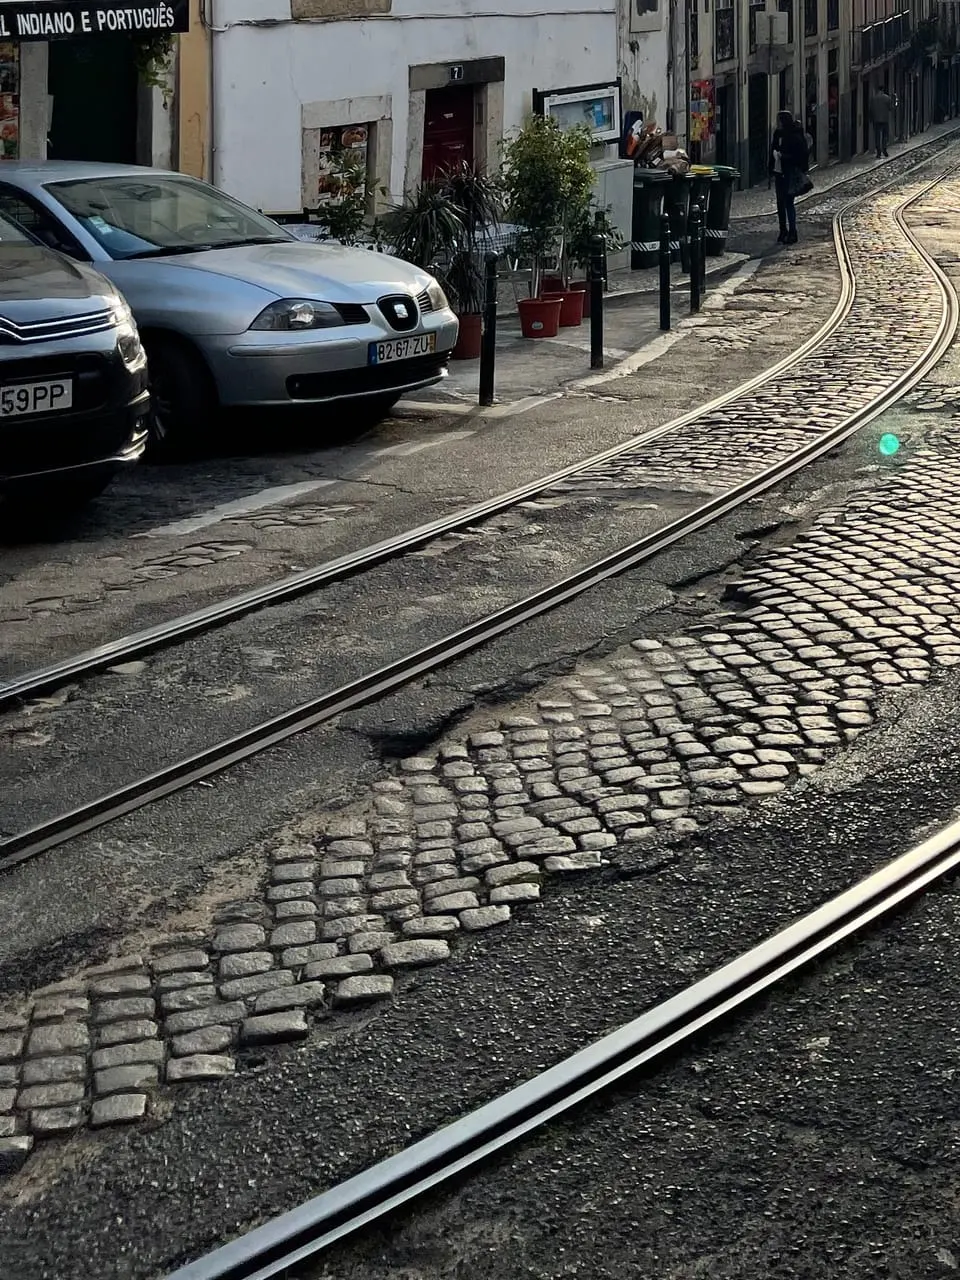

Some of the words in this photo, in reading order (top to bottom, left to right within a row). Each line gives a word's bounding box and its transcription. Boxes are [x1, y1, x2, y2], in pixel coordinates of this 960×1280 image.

[0, 15, 11, 37] L
[17, 11, 75, 36] INDIANO
[81, 11, 92, 32] E
[97, 1, 175, 32] PORTUGUÊS
